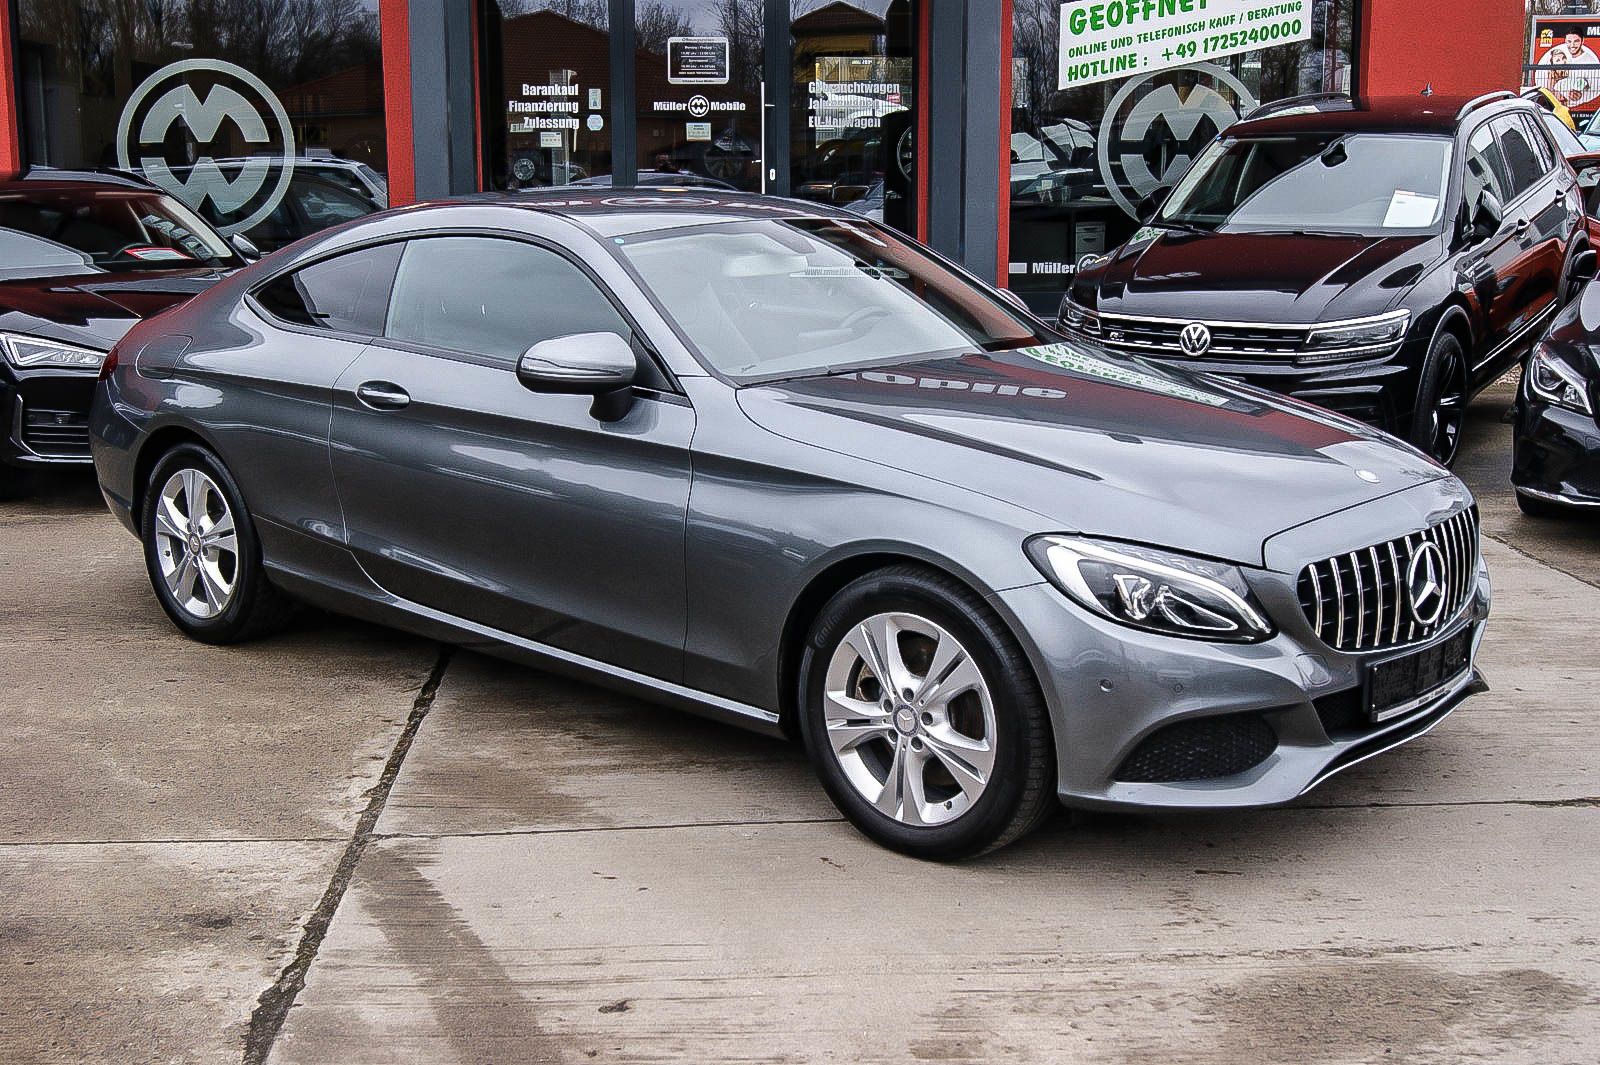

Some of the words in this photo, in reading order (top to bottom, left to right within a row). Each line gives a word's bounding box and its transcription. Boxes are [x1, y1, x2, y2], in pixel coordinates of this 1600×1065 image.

[1068, 41, 1107, 58] ONLINE
[1110, 36, 1133, 50] UND
[1136, 20, 1206, 44] TELEFONISCH
[1209, 14, 1236, 30] KAUF
[1247, 0, 1302, 21] BERATUNG
[1067, 52, 1138, 82] HOTLINE
[1203, 18, 1302, 53] 1725240000
[522, 83, 579, 96] Barankauf
[508, 100, 579, 114] Finanzierung
[653, 101, 687, 111] Müller
[710, 101, 746, 111] Mobile
[523, 116, 580, 130] Zulassung
[1032, 261, 1076, 274] Müller
